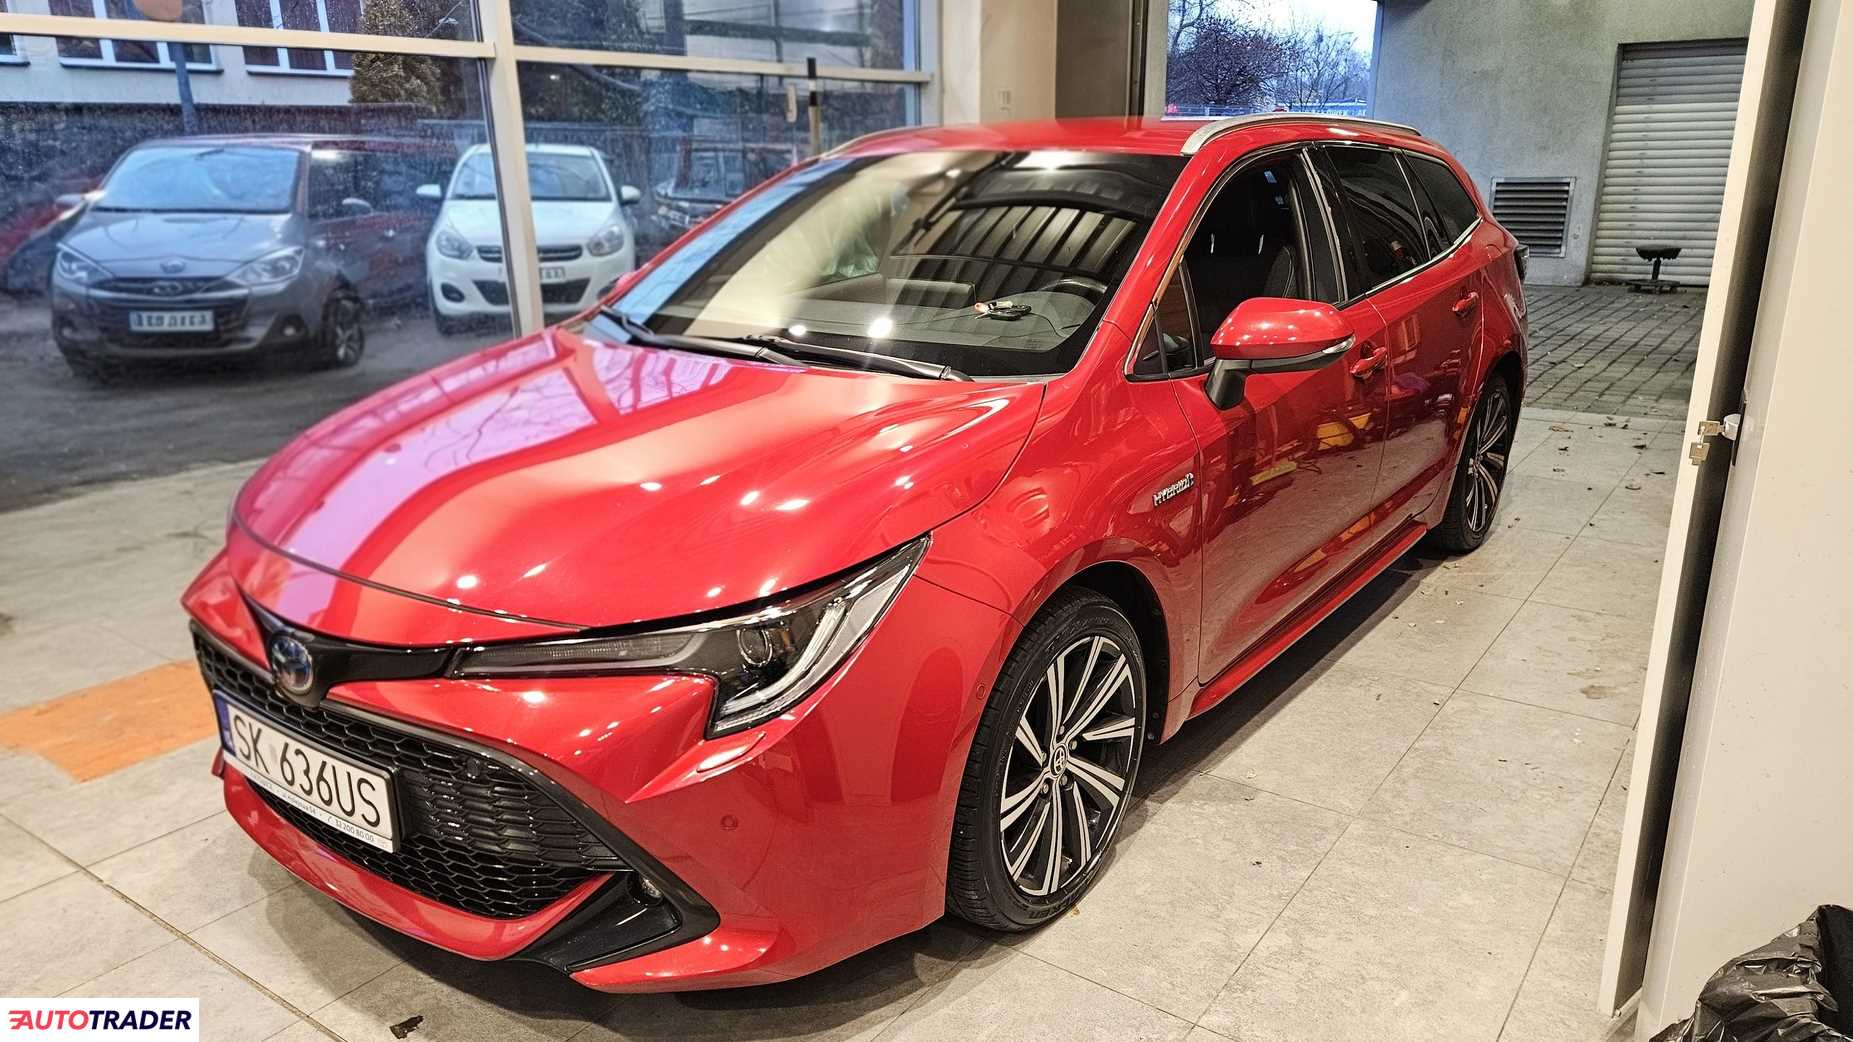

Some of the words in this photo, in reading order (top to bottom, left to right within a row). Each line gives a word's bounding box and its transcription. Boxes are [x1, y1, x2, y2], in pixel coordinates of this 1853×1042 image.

[1153, 473, 1195, 507] HYBRID
[233, 714, 270, 775] SK
[280, 741, 381, 828] 636US
